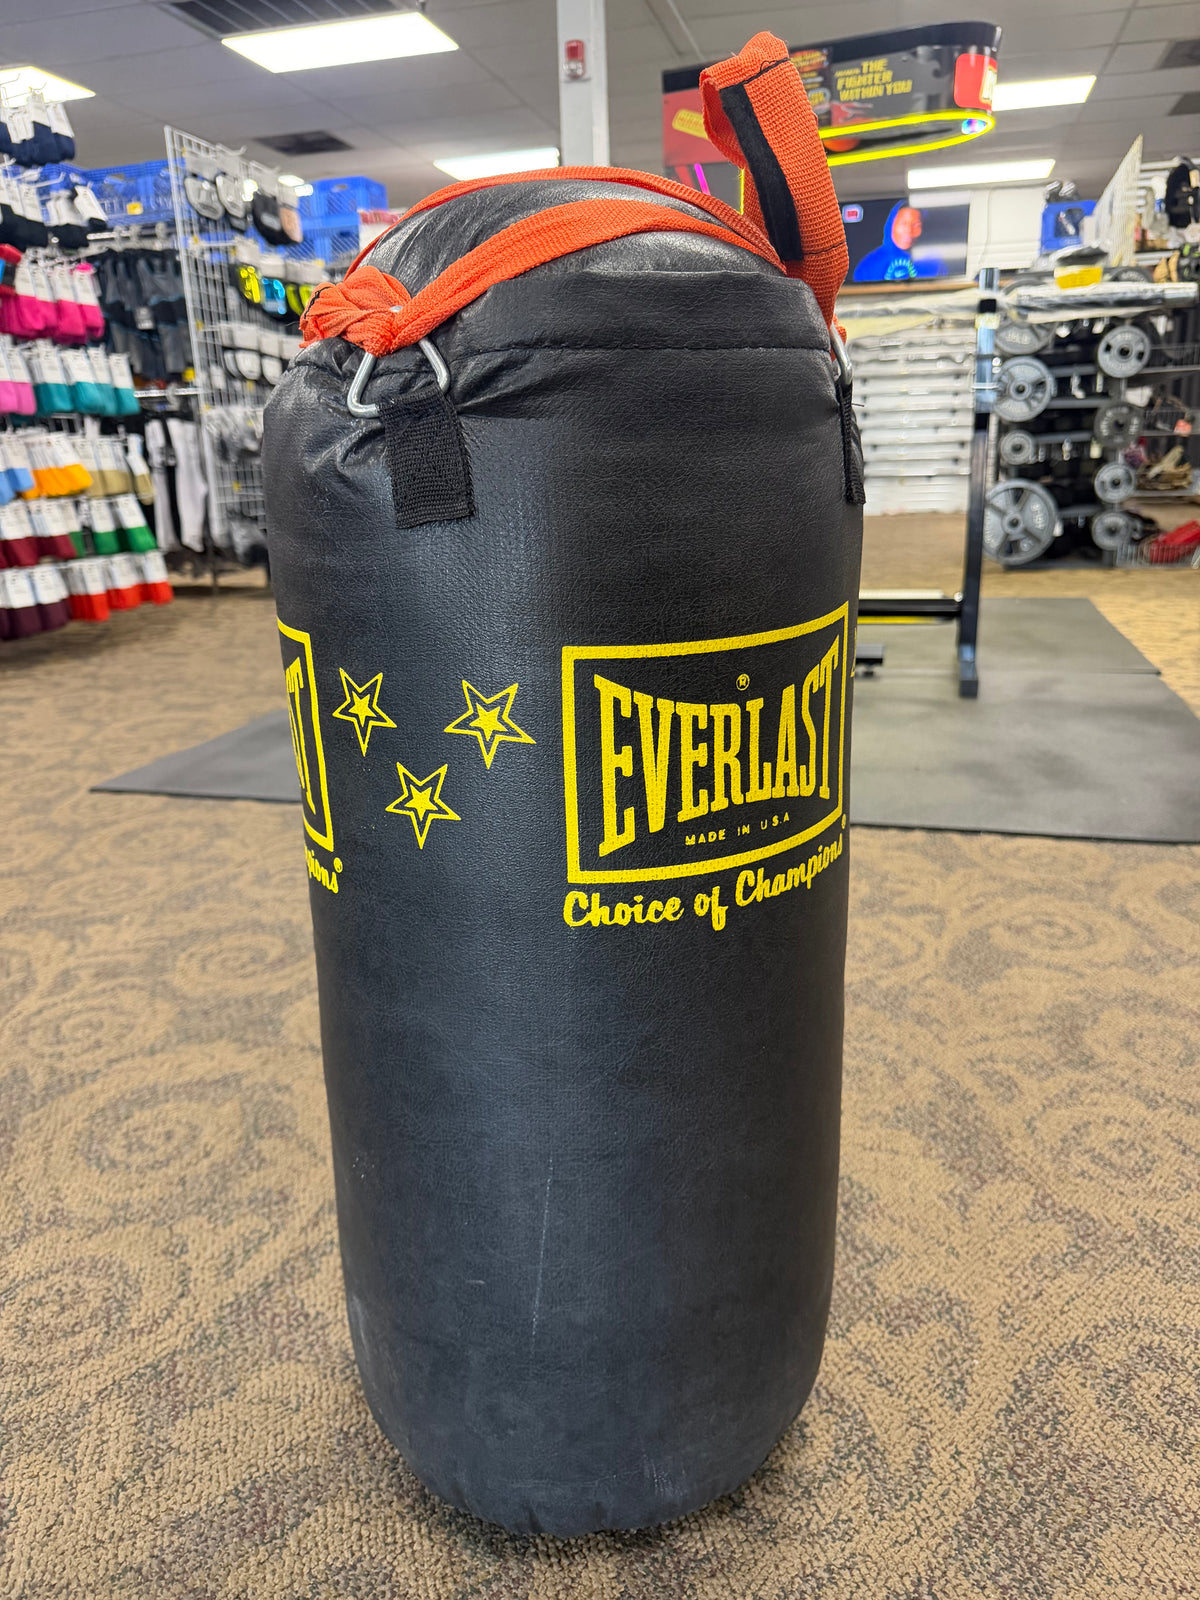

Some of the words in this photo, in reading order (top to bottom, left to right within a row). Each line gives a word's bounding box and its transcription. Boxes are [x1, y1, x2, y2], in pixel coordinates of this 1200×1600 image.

[862, 58, 888, 74] THE
[840, 85, 884, 101] WITHIN
[886, 79, 913, 95] YOU
[594, 634, 839, 857] EVERLAST
[684, 829, 726, 846] MADE
[737, 824, 750, 836] IN
[563, 890, 684, 927] Choice
[694, 885, 728, 931] of
[735, 832, 843, 907] Champions
